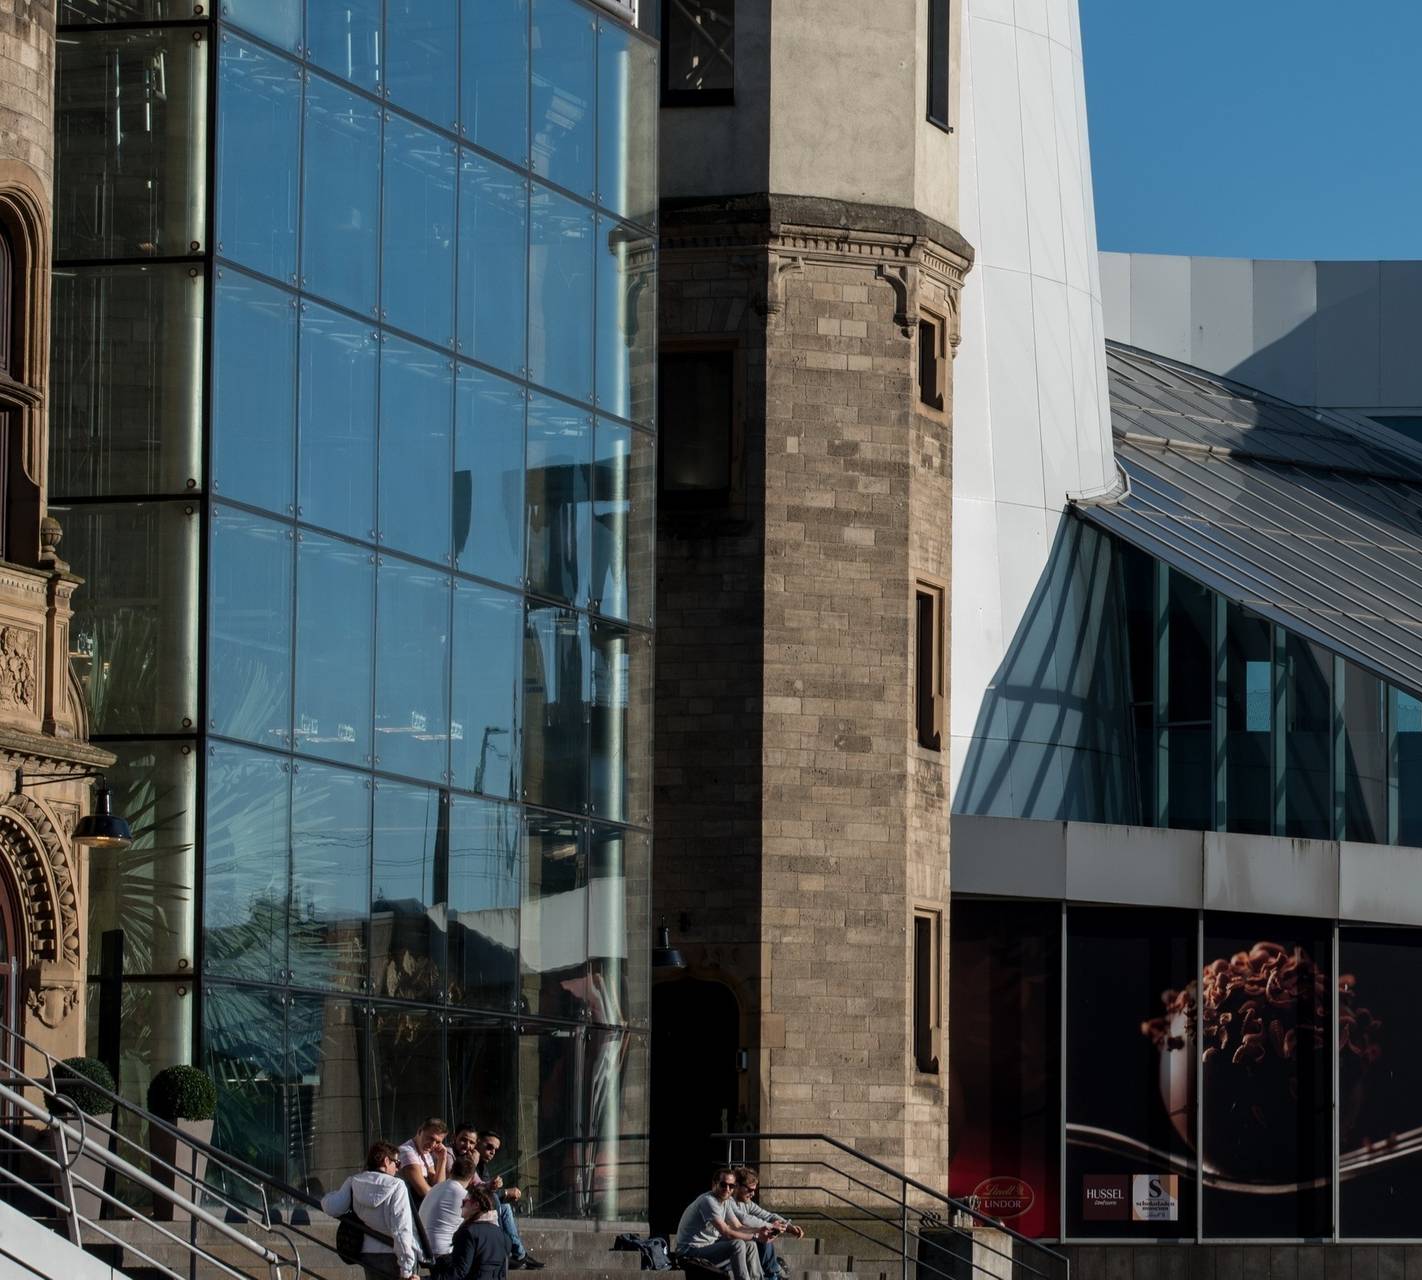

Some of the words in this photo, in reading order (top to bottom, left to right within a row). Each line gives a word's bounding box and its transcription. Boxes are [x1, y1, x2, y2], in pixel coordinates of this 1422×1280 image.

[1086, 1188, 1122, 1199] HUSSEL
[1149, 1178, 1162, 1198] S
[984, 1199, 1021, 1209] LINDOR
